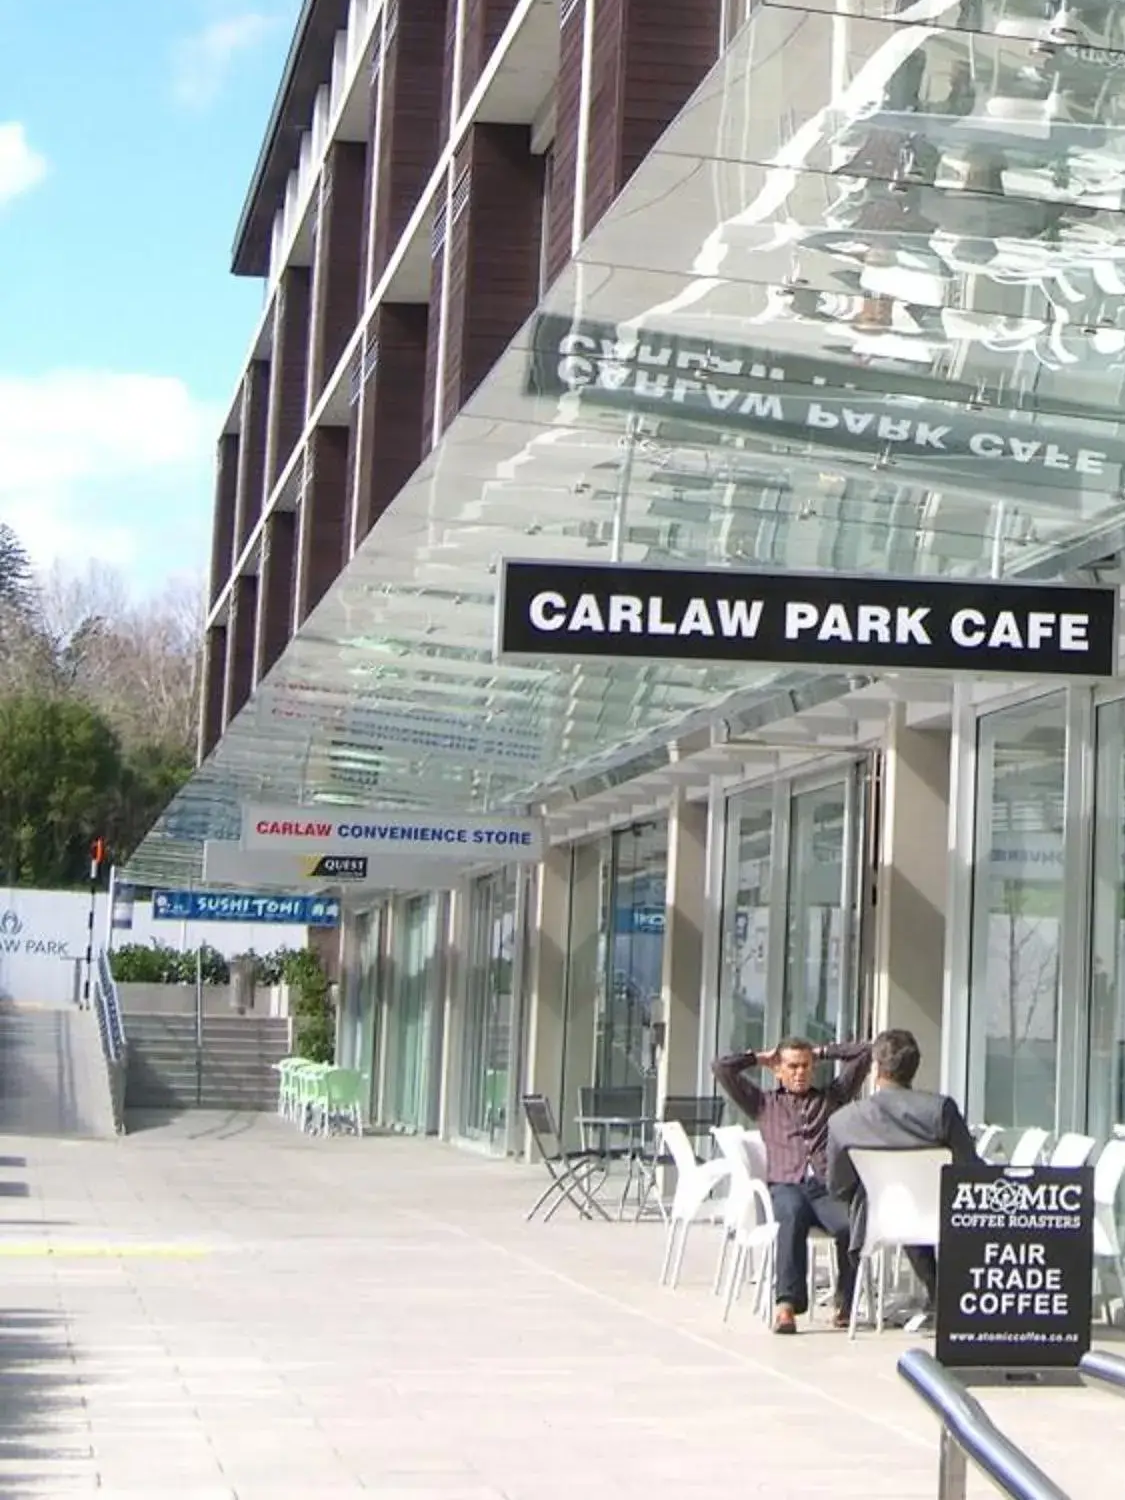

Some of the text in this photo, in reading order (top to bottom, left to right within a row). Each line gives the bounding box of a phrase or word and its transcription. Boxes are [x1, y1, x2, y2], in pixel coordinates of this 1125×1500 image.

[529, 591, 1090, 652] CARLAW PARK CAFE
[255, 820, 532, 846] CARLAW CONVENIENCE STORE
[324, 858, 364, 871] QUEST
[197, 897, 249, 912] SUSHI
[25, 940, 69, 956] PARK
[952, 1179, 1082, 1214] ATOMIC
[951, 1214, 1081, 1229] COFFEE ROASTERS
[985, 1243, 1046, 1265] FAIR
[970, 1268, 1062, 1290] TRADE
[960, 1292, 1069, 1315] COFFEE
[949, 1331, 1079, 1343] www.atomiccoffee.co.nz
